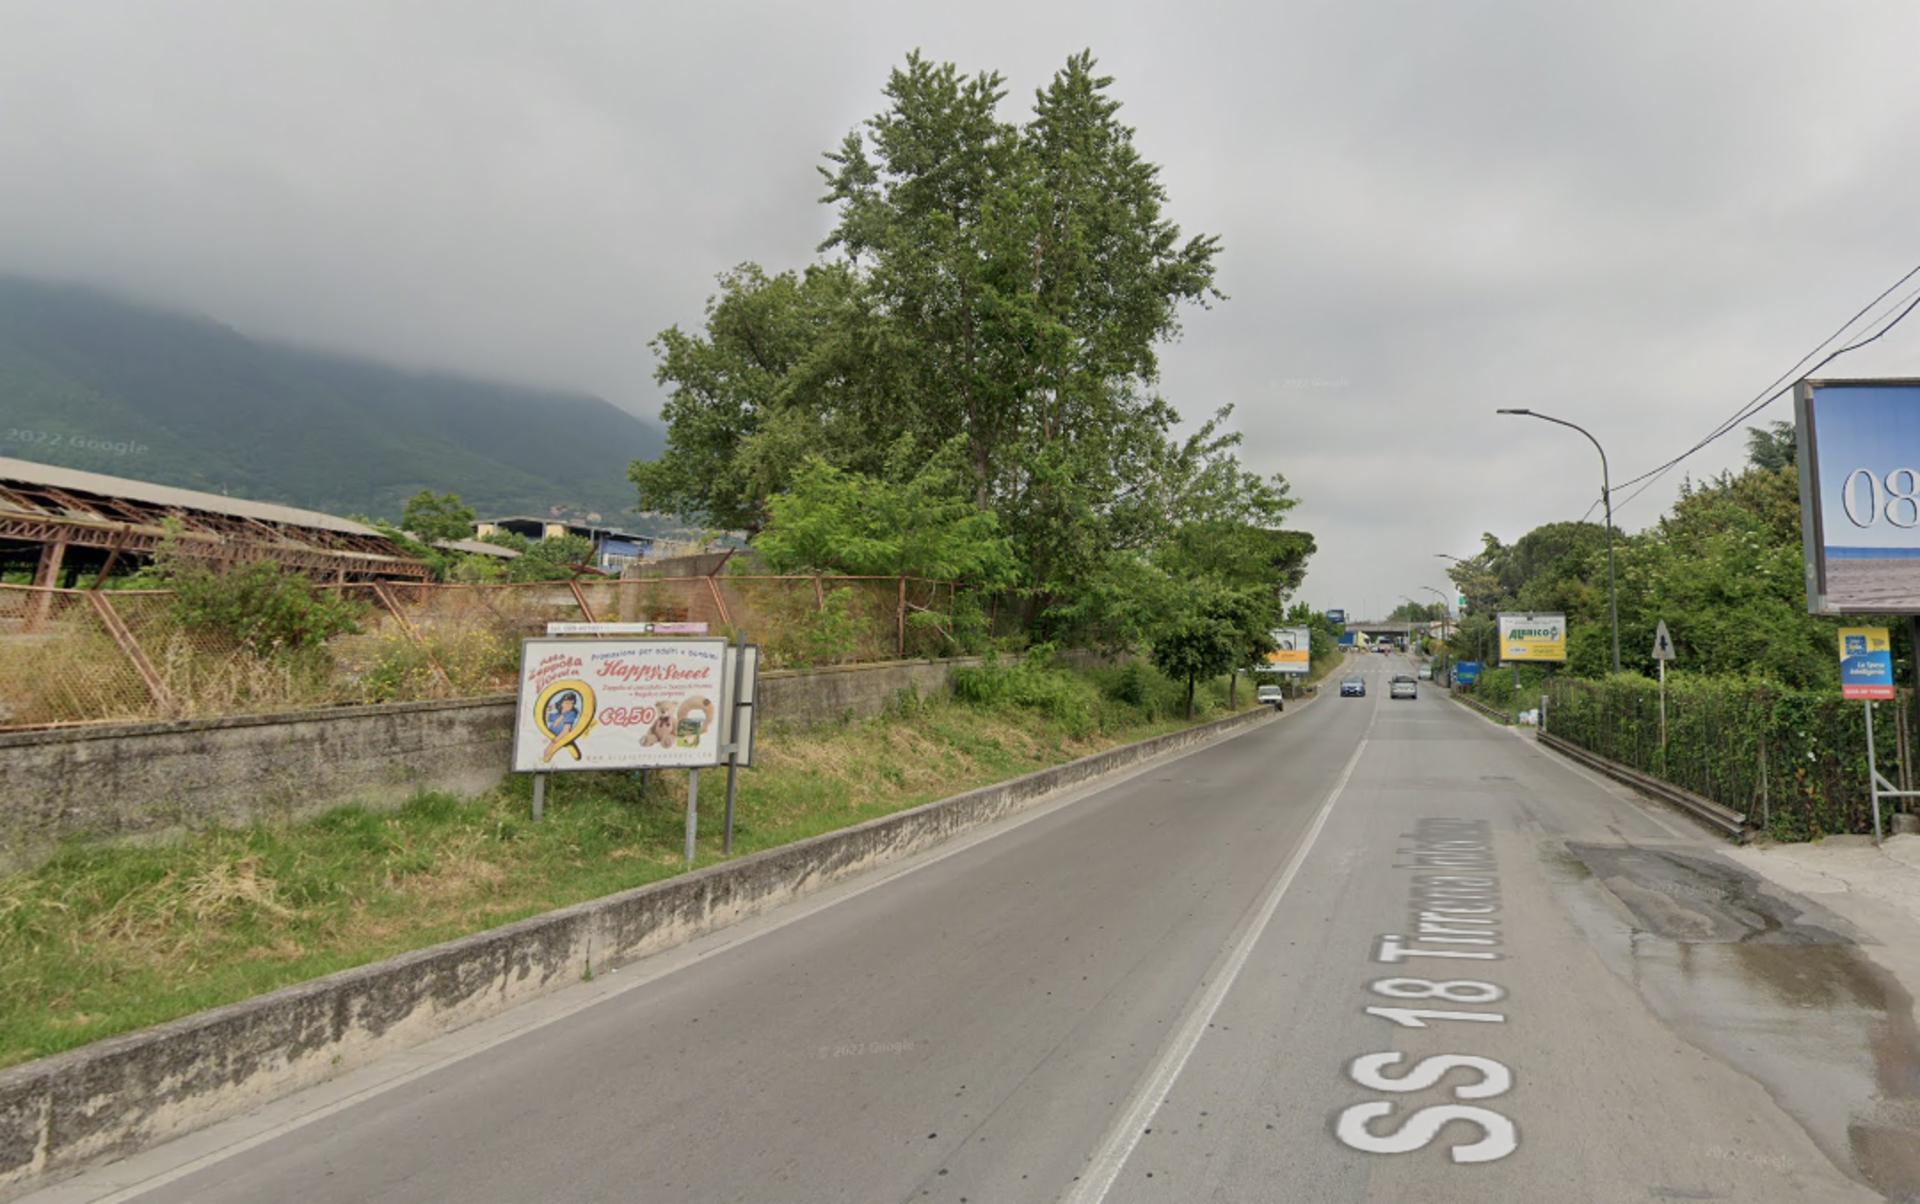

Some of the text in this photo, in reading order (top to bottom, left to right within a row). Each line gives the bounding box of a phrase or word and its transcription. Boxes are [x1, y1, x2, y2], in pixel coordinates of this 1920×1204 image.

[638, 648, 652, 656] per
[597, 659, 710, 682] Happy Sweet
[600, 706, 657, 727] €2,50
[1365, 977, 1505, 1028] 18
[1336, 1051, 1518, 1164] SS
